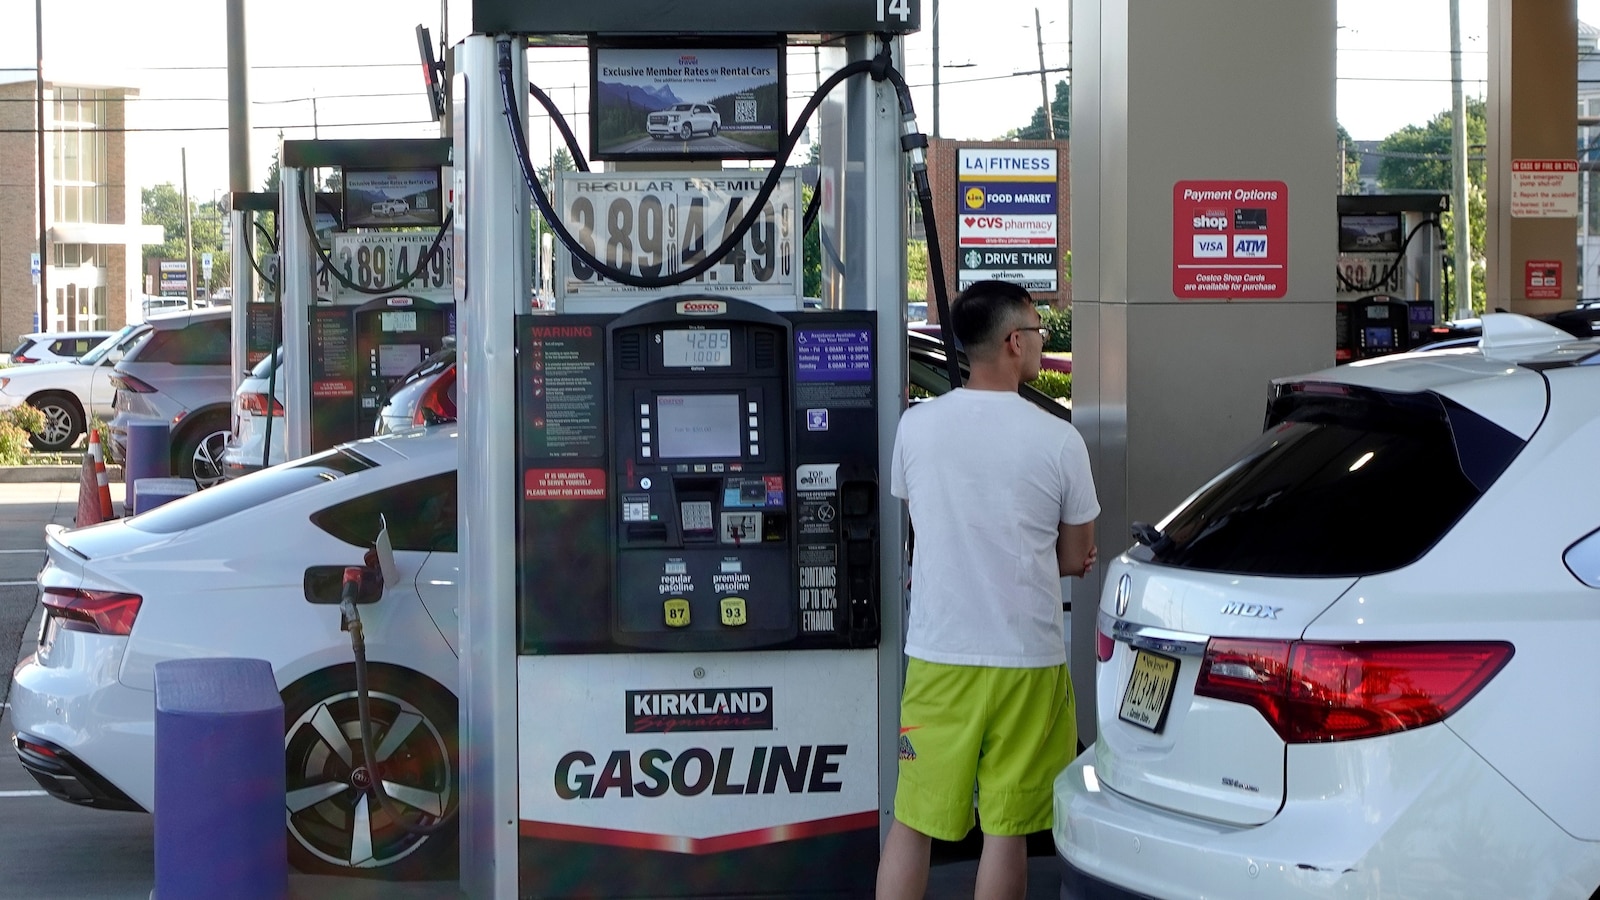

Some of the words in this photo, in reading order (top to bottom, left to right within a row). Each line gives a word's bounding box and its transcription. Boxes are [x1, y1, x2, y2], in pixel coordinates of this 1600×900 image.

[877, 0, 910, 21] 14
[603, 67, 644, 76] Exclusive
[646, 67, 682, 76] Member
[684, 66, 708, 76] Rates
[721, 66, 749, 76] Rental
[752, 67, 770, 76] Cars
[966, 158, 983, 168] LA
[990, 158, 1050, 170] FITNESS
[577, 181, 672, 192] REGULAR
[685, 180, 782, 192] PREMIU
[987, 194, 1012, 204] FOOD
[1015, 194, 1051, 204] MARKET
[1184, 189, 1232, 202] Payment
[1234, 189, 1278, 202] Options
[1439, 196, 1447, 209] 4
[977, 218, 1003, 228] CVS
[1005, 219, 1052, 232] pharmacy
[1194, 215, 1227, 230] shop
[682, 197, 775, 282] 4.49
[1198, 242, 1223, 251] VISA
[1236, 240, 1266, 252] ATM
[985, 253, 1018, 264] DRIVE
[1022, 253, 1052, 264] THRU
[1223, 274, 1242, 283] Shop
[1242, 283, 1276, 292] purchase
[532, 326, 592, 336] WARNING
[655, 334, 661, 344] $
[661, 574, 692, 584] regular
[713, 573, 750, 584] premium
[800, 566, 836, 588] CONTAINS
[659, 582, 694, 594] gasoline
[714, 581, 750, 594] gasoline
[800, 588, 810, 610] UP
[810, 588, 820, 610] TO
[820, 588, 838, 610] 10%
[670, 608, 685, 618] 87
[726, 608, 741, 618] 93
[1220, 600, 1283, 620] MDX
[803, 610, 834, 632] ETHANOL
[634, 692, 768, 716] KIRKLAND
[633, 715, 767, 734] Signature
[554, 744, 848, 800] GASOLINE
